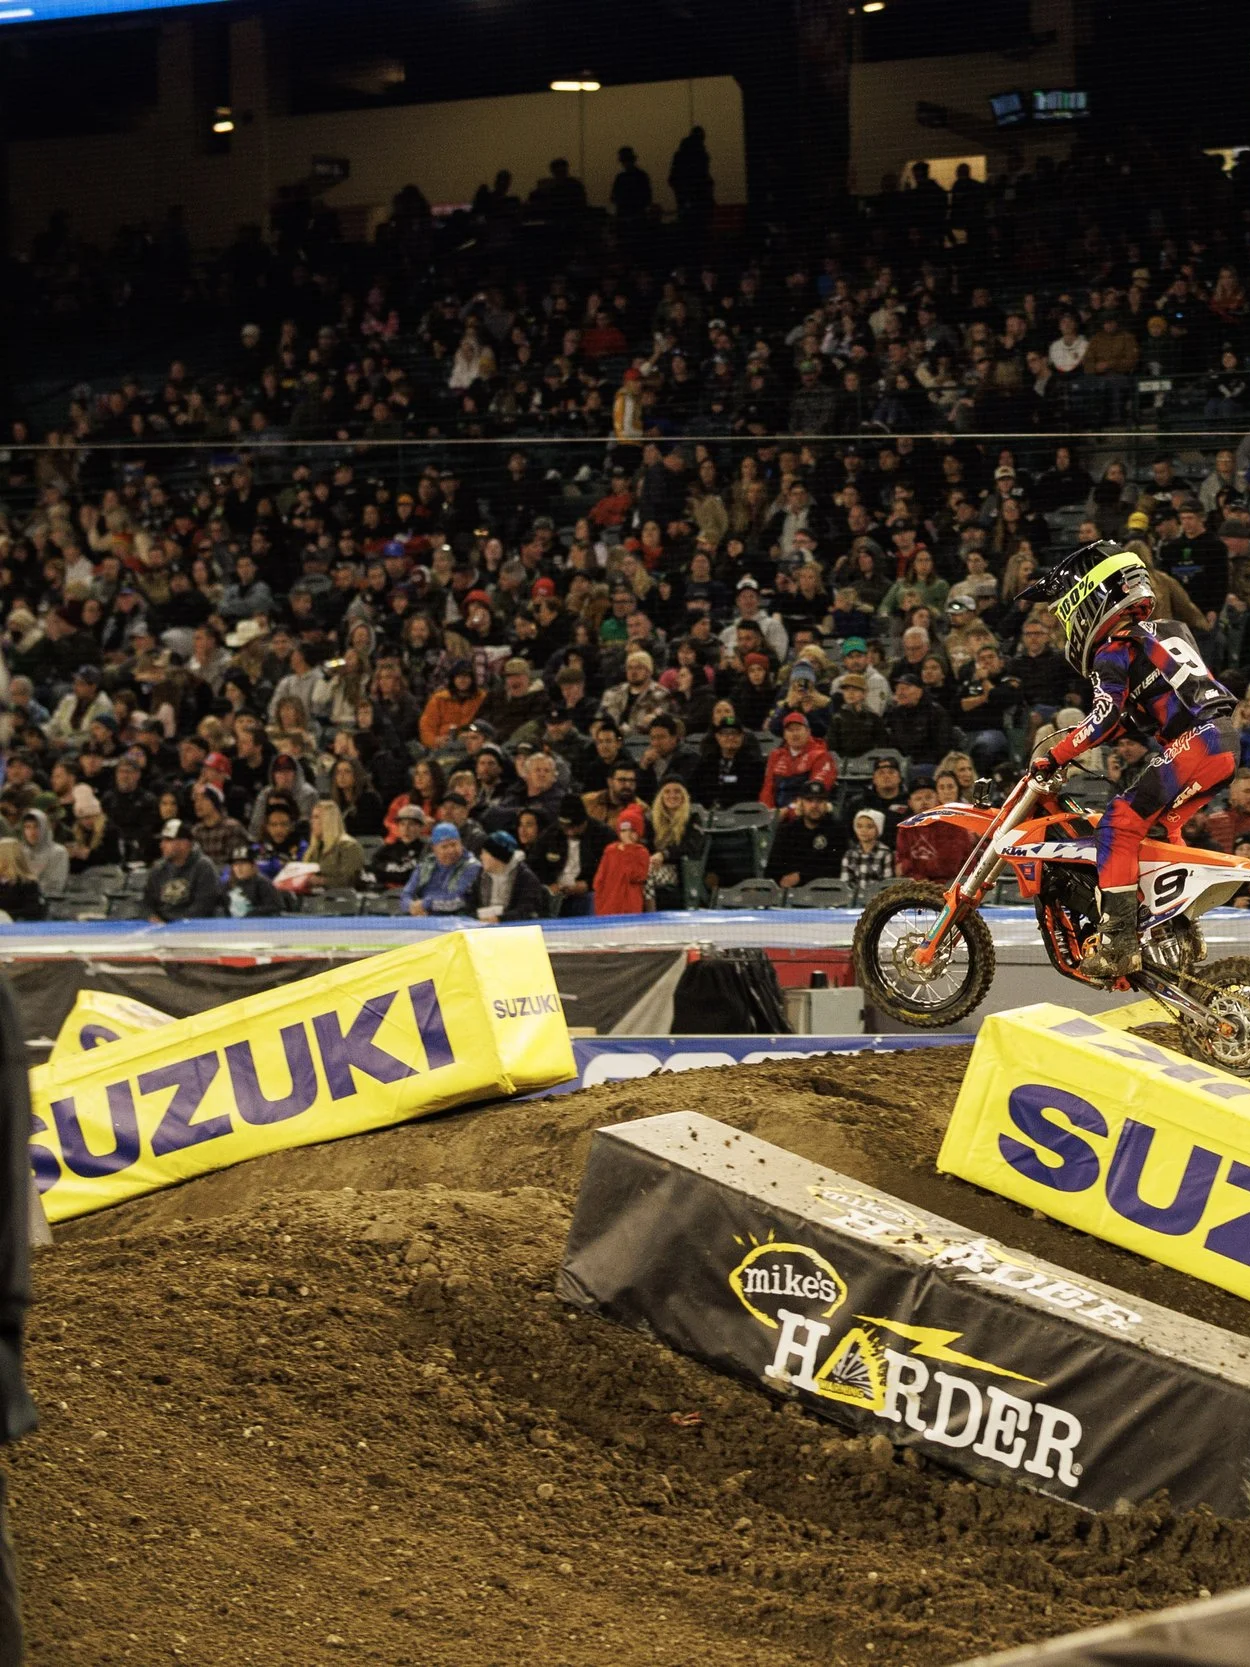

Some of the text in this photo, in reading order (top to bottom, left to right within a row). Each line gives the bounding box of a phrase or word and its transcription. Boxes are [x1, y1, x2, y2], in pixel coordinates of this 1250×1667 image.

[1059, 575, 1095, 620] 100%
[1072, 724, 1096, 748] KTM
[1001, 847, 1028, 857] KTM
[1154, 868, 1188, 907] 9
[493, 993, 560, 1019] SUZUKI
[743, 1263, 837, 1304] mike's
